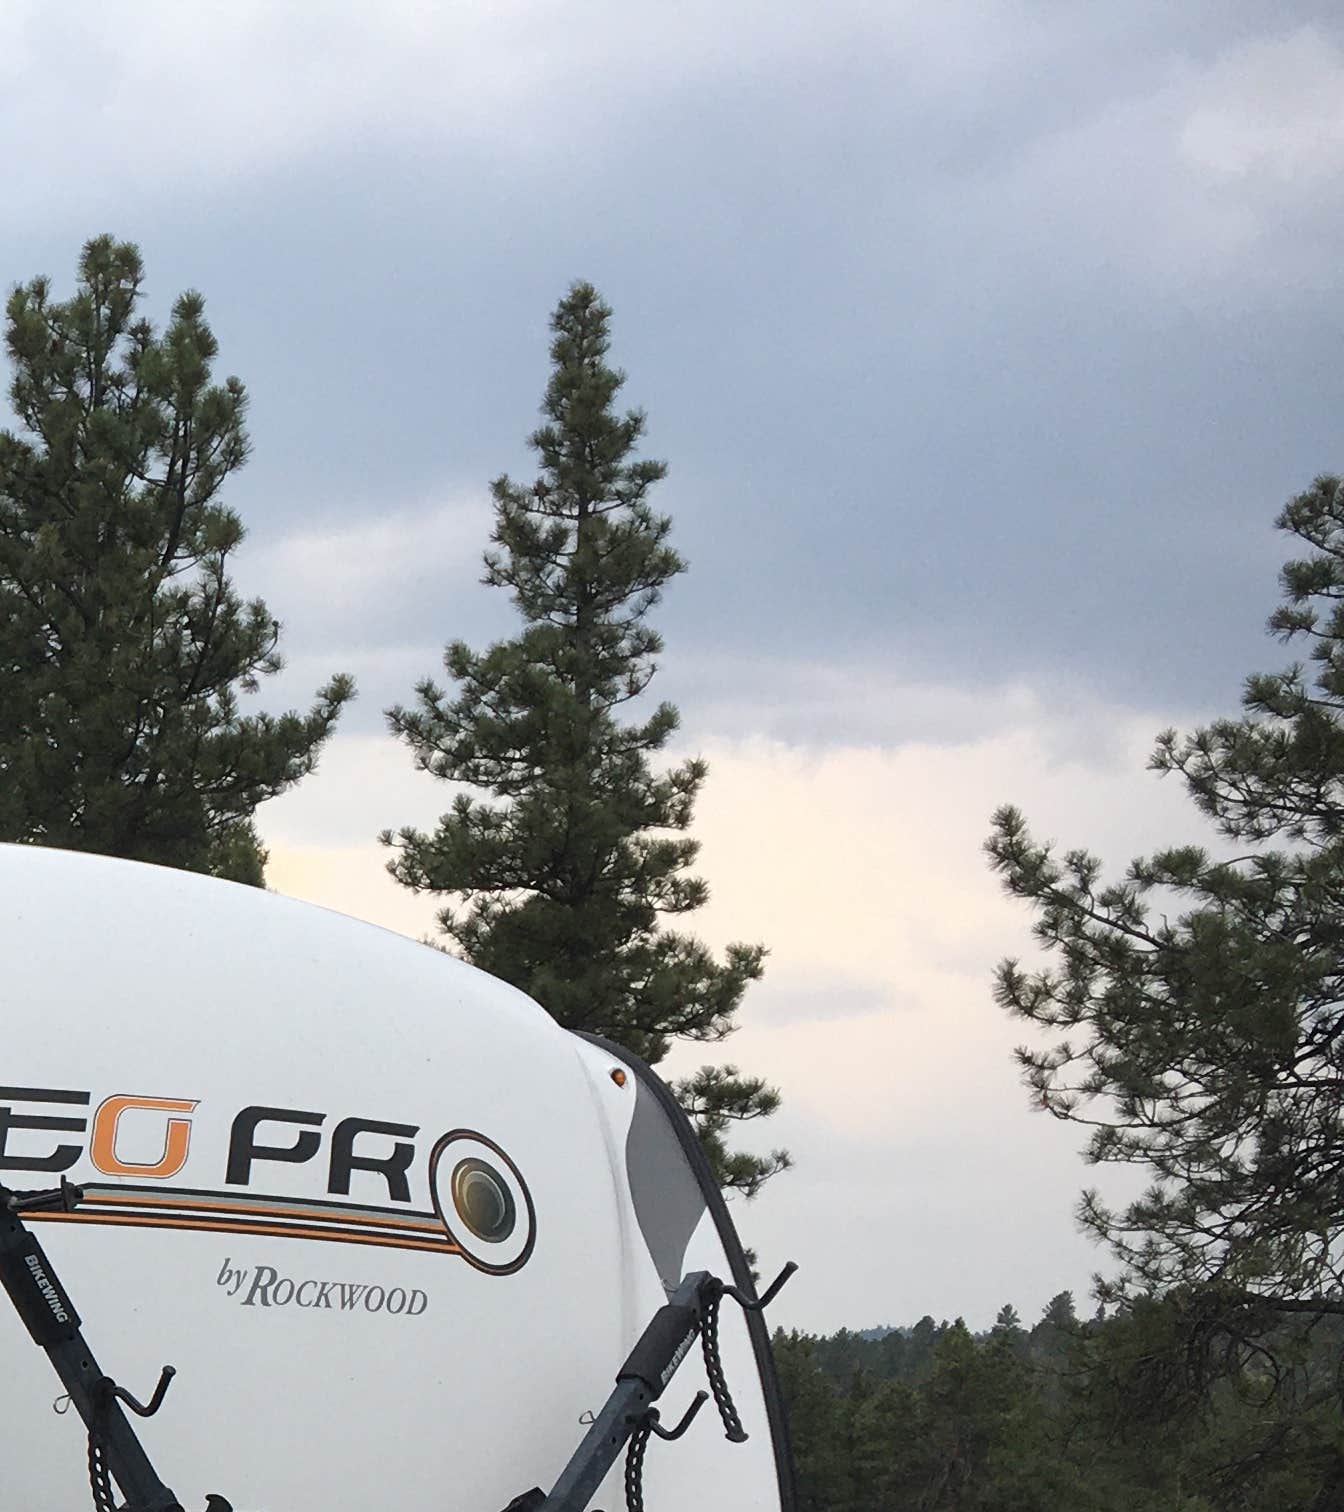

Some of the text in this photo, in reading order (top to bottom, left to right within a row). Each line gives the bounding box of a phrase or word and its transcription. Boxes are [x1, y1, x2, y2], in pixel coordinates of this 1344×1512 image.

[24, 1254, 69, 1324] BIKEWING
[216, 1257, 429, 1316] by ROCKWOOD
